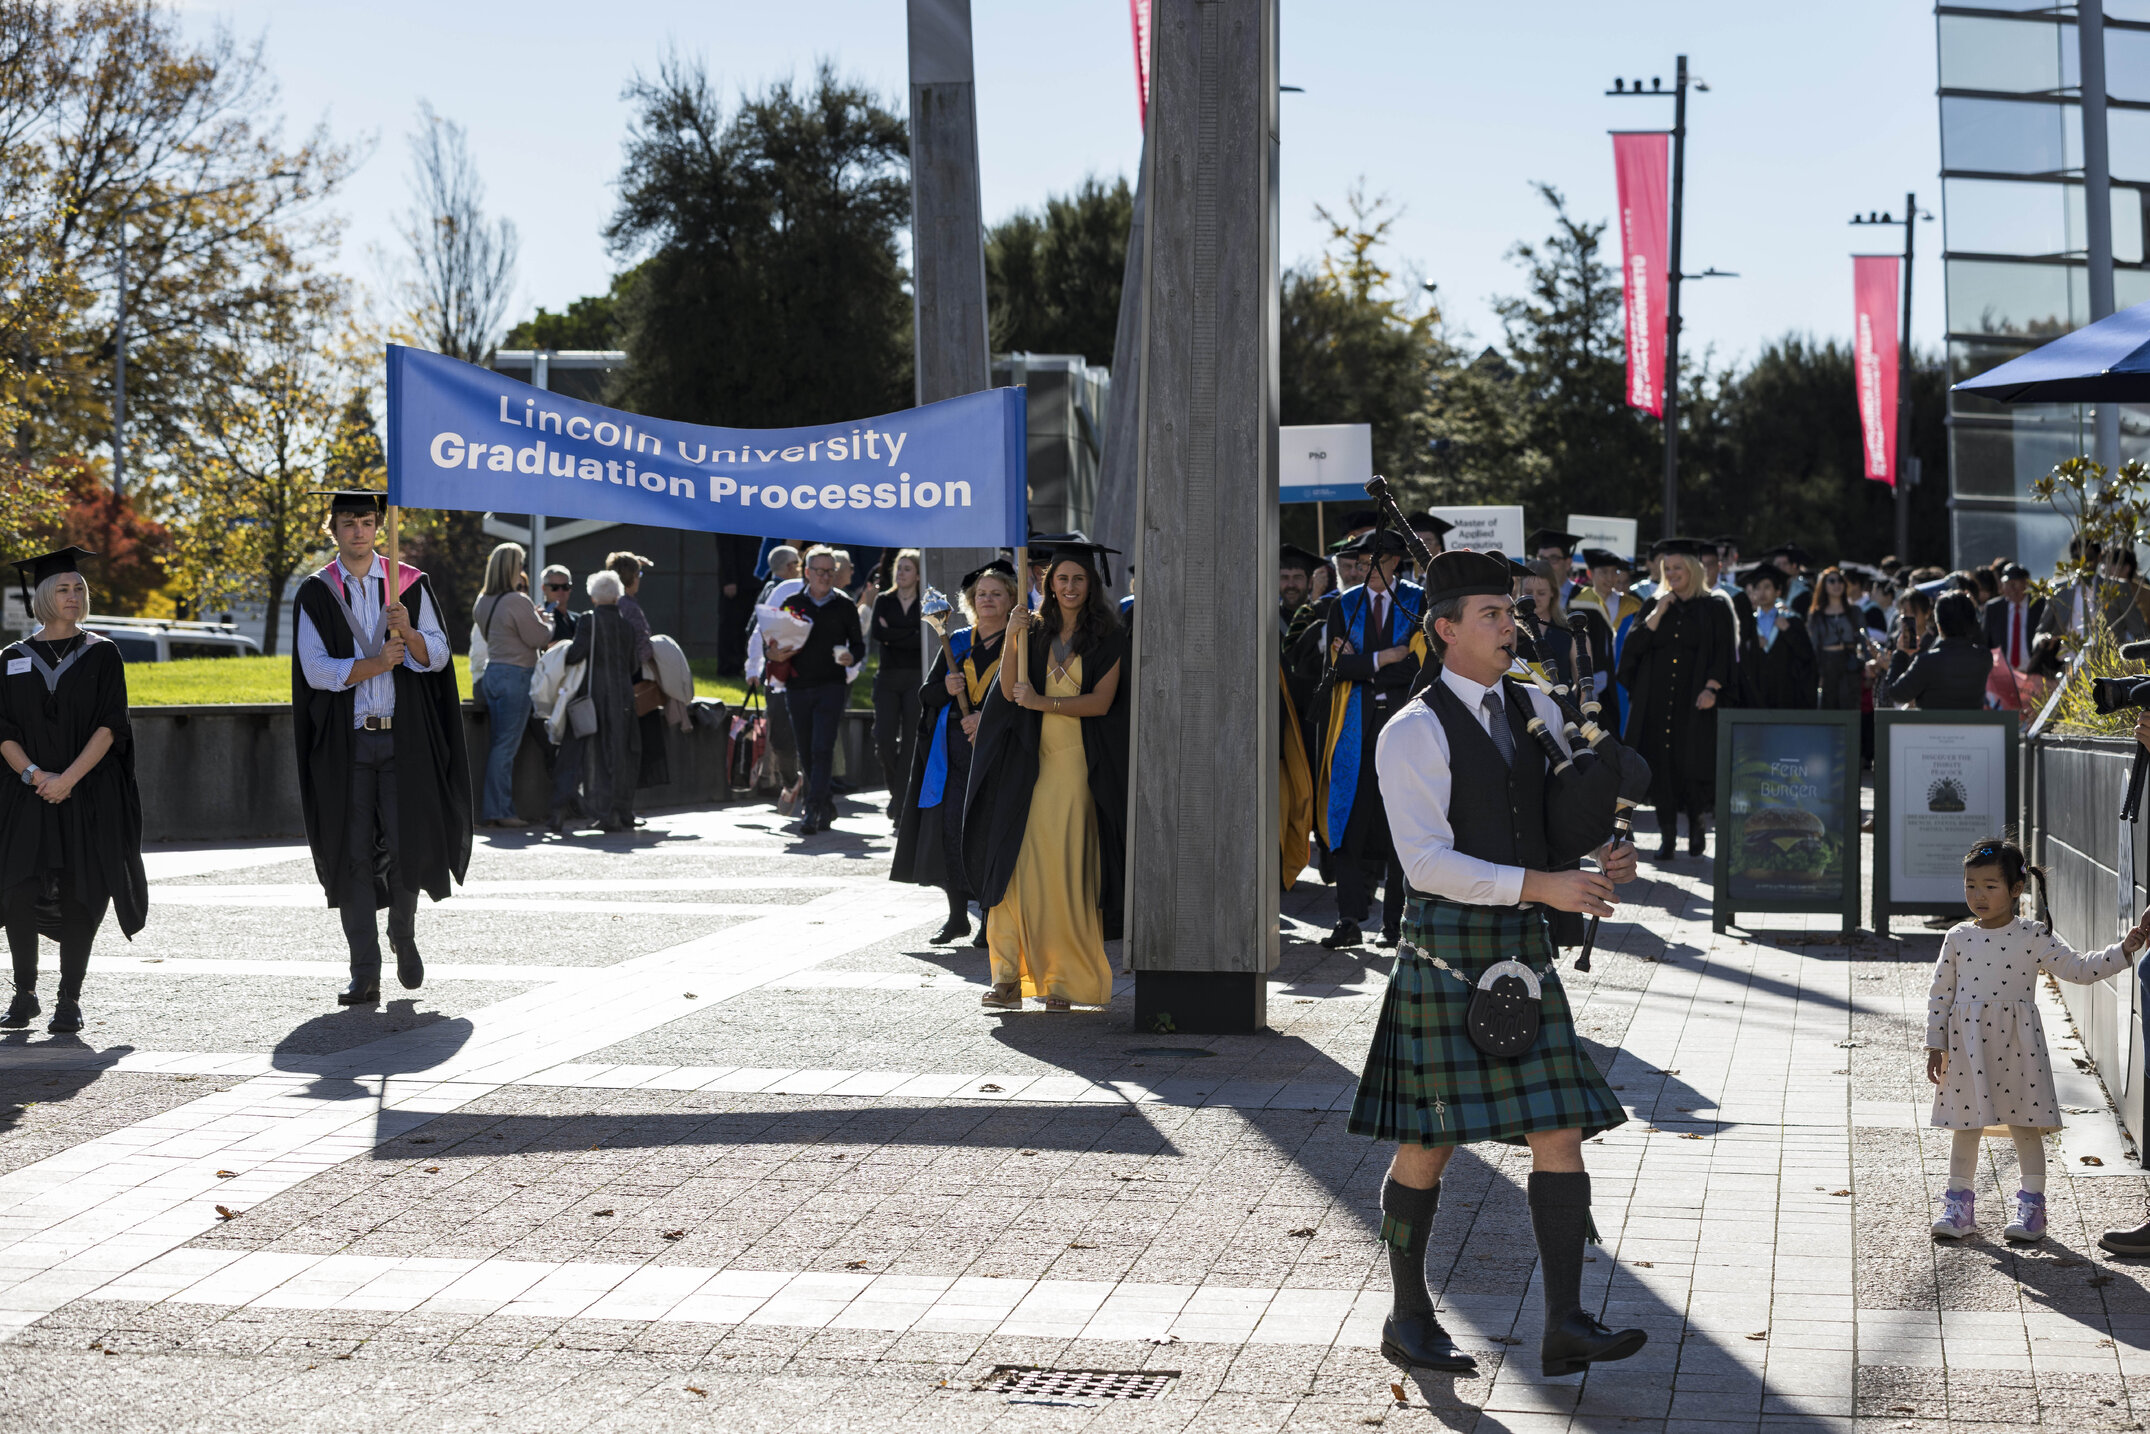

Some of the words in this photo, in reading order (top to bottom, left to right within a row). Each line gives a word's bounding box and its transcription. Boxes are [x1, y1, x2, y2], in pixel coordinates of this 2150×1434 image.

[500, 395, 662, 456] Lincoln
[678, 429, 907, 467] University
[1308, 451, 1327, 460] PhD
[430, 432, 695, 499] Graduation
[710, 472, 972, 510] Procession
[1454, 519, 1485, 527] Master
[1487, 517, 1498, 527] of
[1458, 530, 1494, 539] Applied
[1451, 541, 1503, 550] Computing
